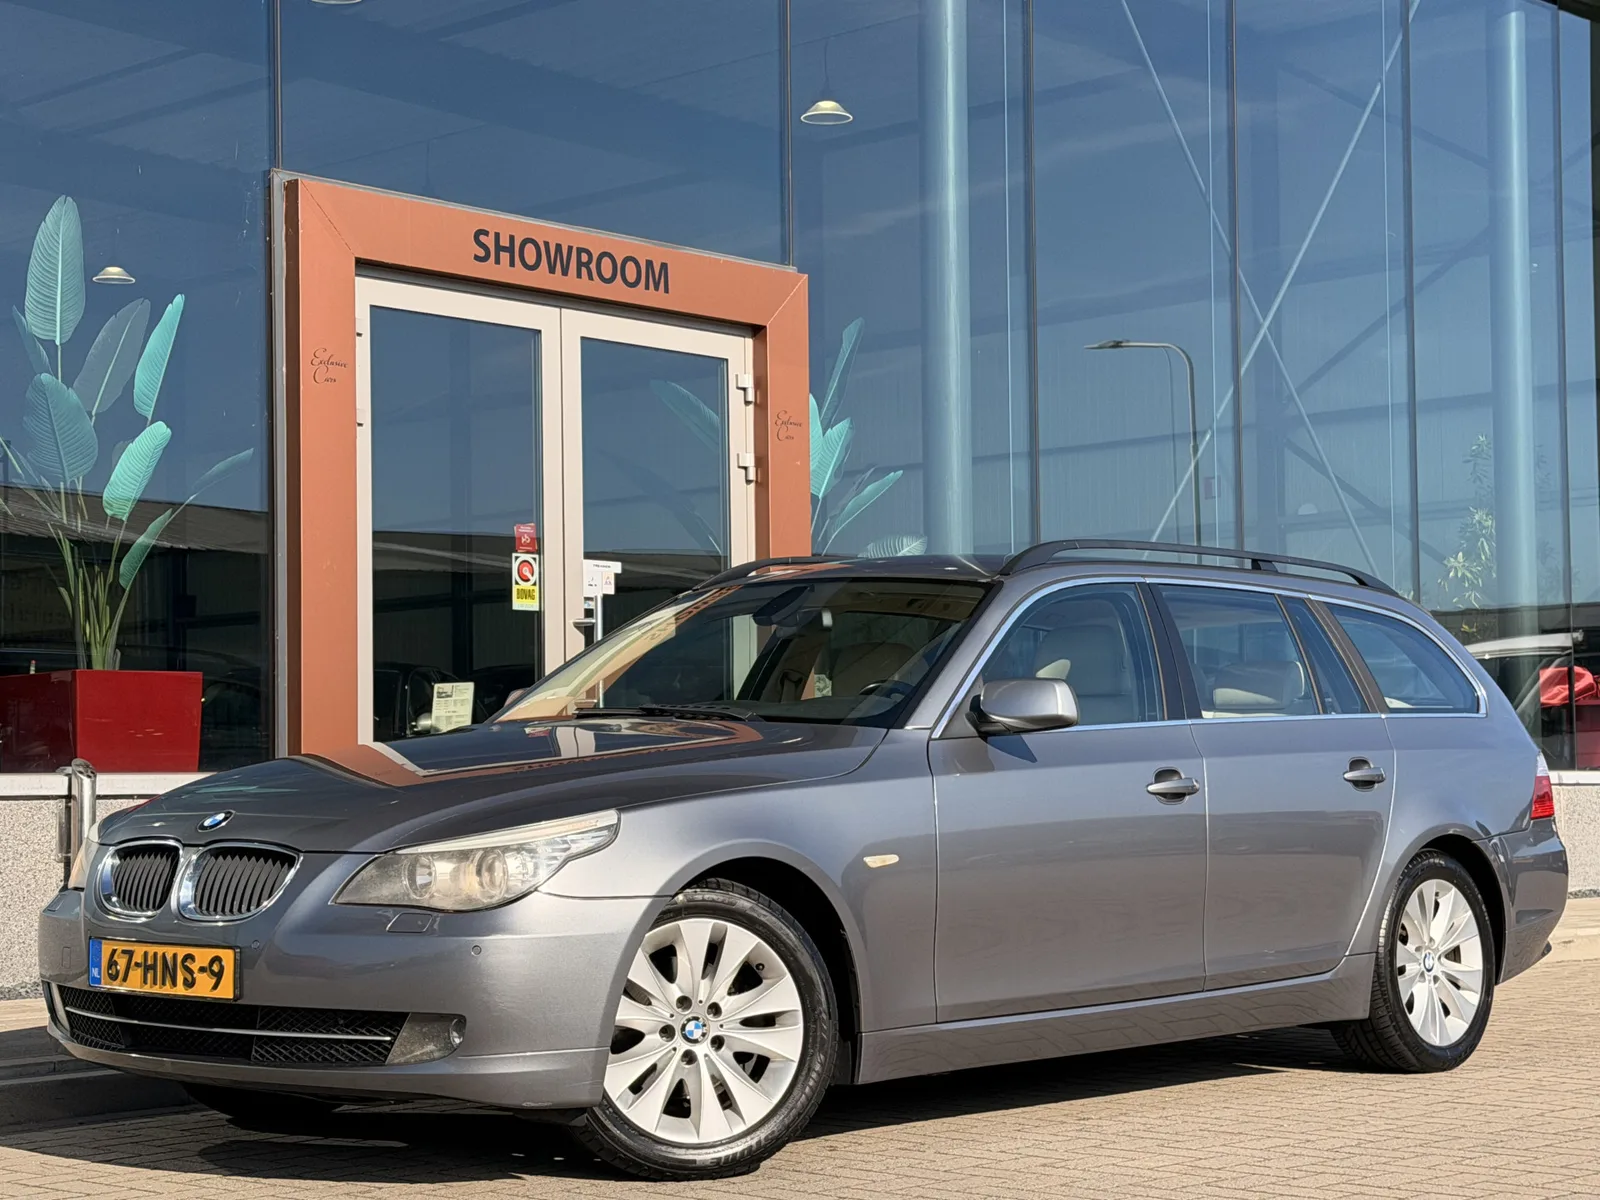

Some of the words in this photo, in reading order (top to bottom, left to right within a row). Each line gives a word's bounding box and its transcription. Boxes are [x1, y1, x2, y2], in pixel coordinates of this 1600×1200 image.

[473, 229, 669, 294] SHOWROOM
[310, 347, 348, 368] Exclusive
[516, 588, 535, 601] BOVAG
[91, 967, 101, 978] NL
[107, 948, 225, 992] 67-HNS-9
